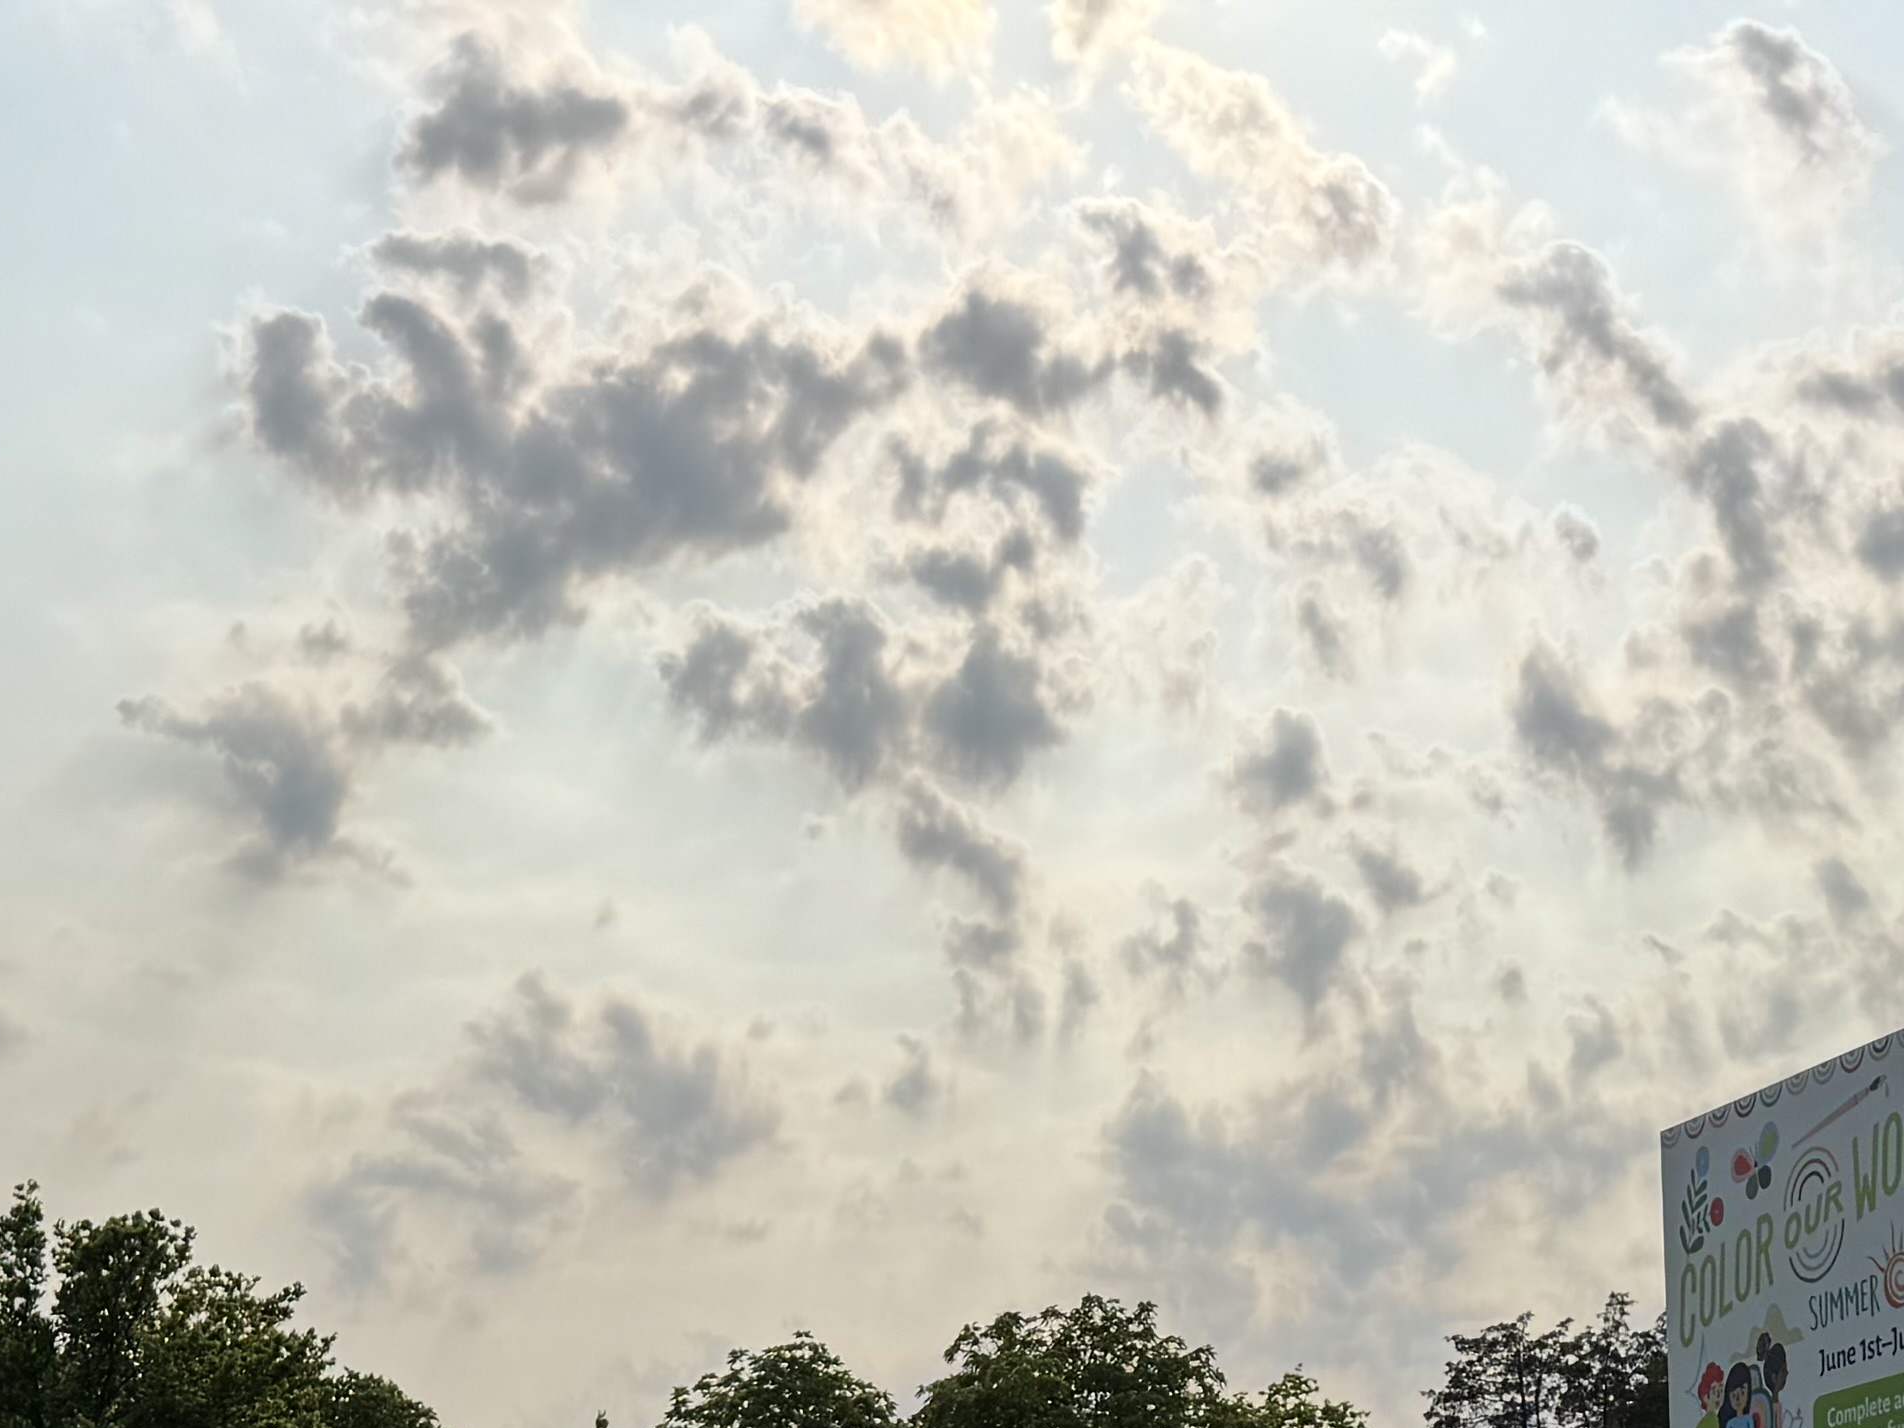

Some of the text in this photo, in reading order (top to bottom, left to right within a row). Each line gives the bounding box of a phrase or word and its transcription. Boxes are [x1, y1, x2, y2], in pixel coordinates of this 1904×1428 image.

[1679, 1212, 1775, 1348] COLOR
[1784, 1180, 1844, 1249] OUR
[1809, 1274, 1881, 1332] SUMMER
[1819, 1342, 1856, 1377] June
[1827, 1393, 1891, 1428] Complete
